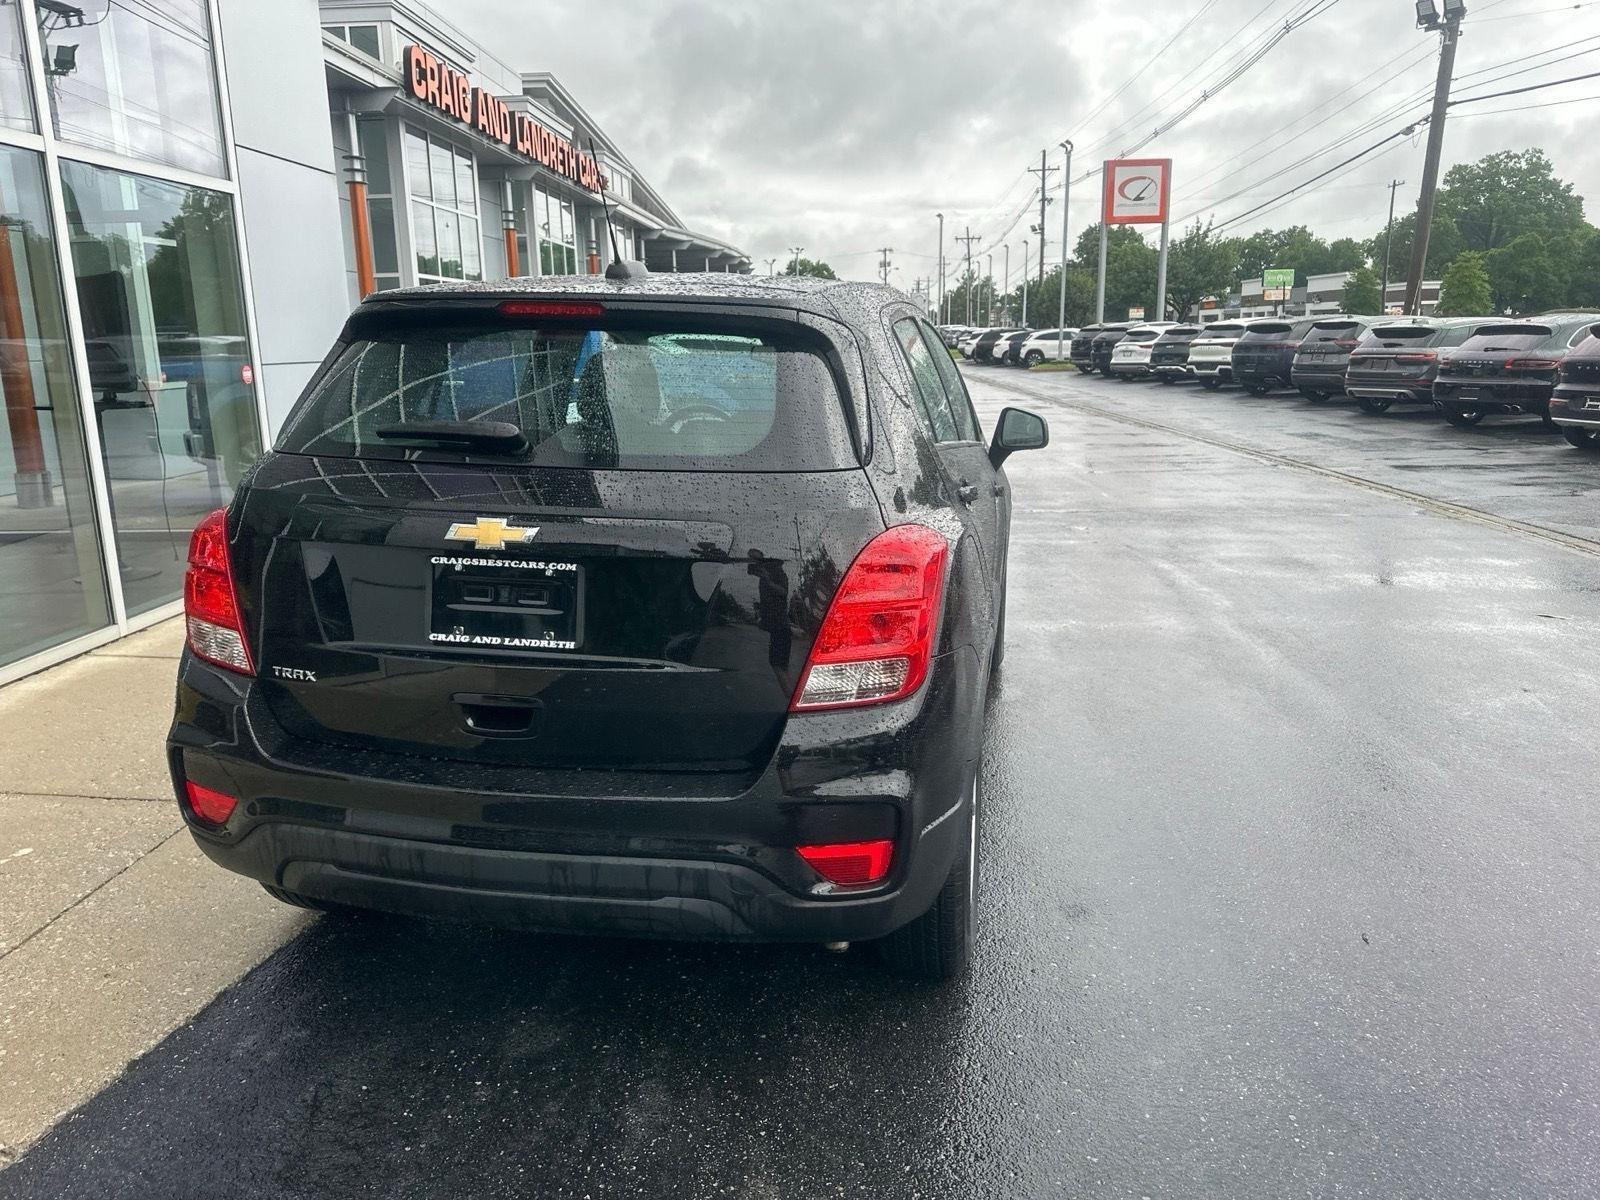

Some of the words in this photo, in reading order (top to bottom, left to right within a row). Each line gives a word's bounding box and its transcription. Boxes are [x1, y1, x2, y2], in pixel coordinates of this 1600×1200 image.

[409, 45, 472, 124] CRAIG
[478, 87, 511, 145] AND
[515, 111, 577, 181] LANDRETH
[430, 556, 578, 571] CRAIGSBESTCARS.COM
[429, 633, 470, 643] CRAIG
[472, 635, 501, 645] AND
[503, 637, 576, 649] LANDRETH
[272, 666, 316, 682] TRAX
